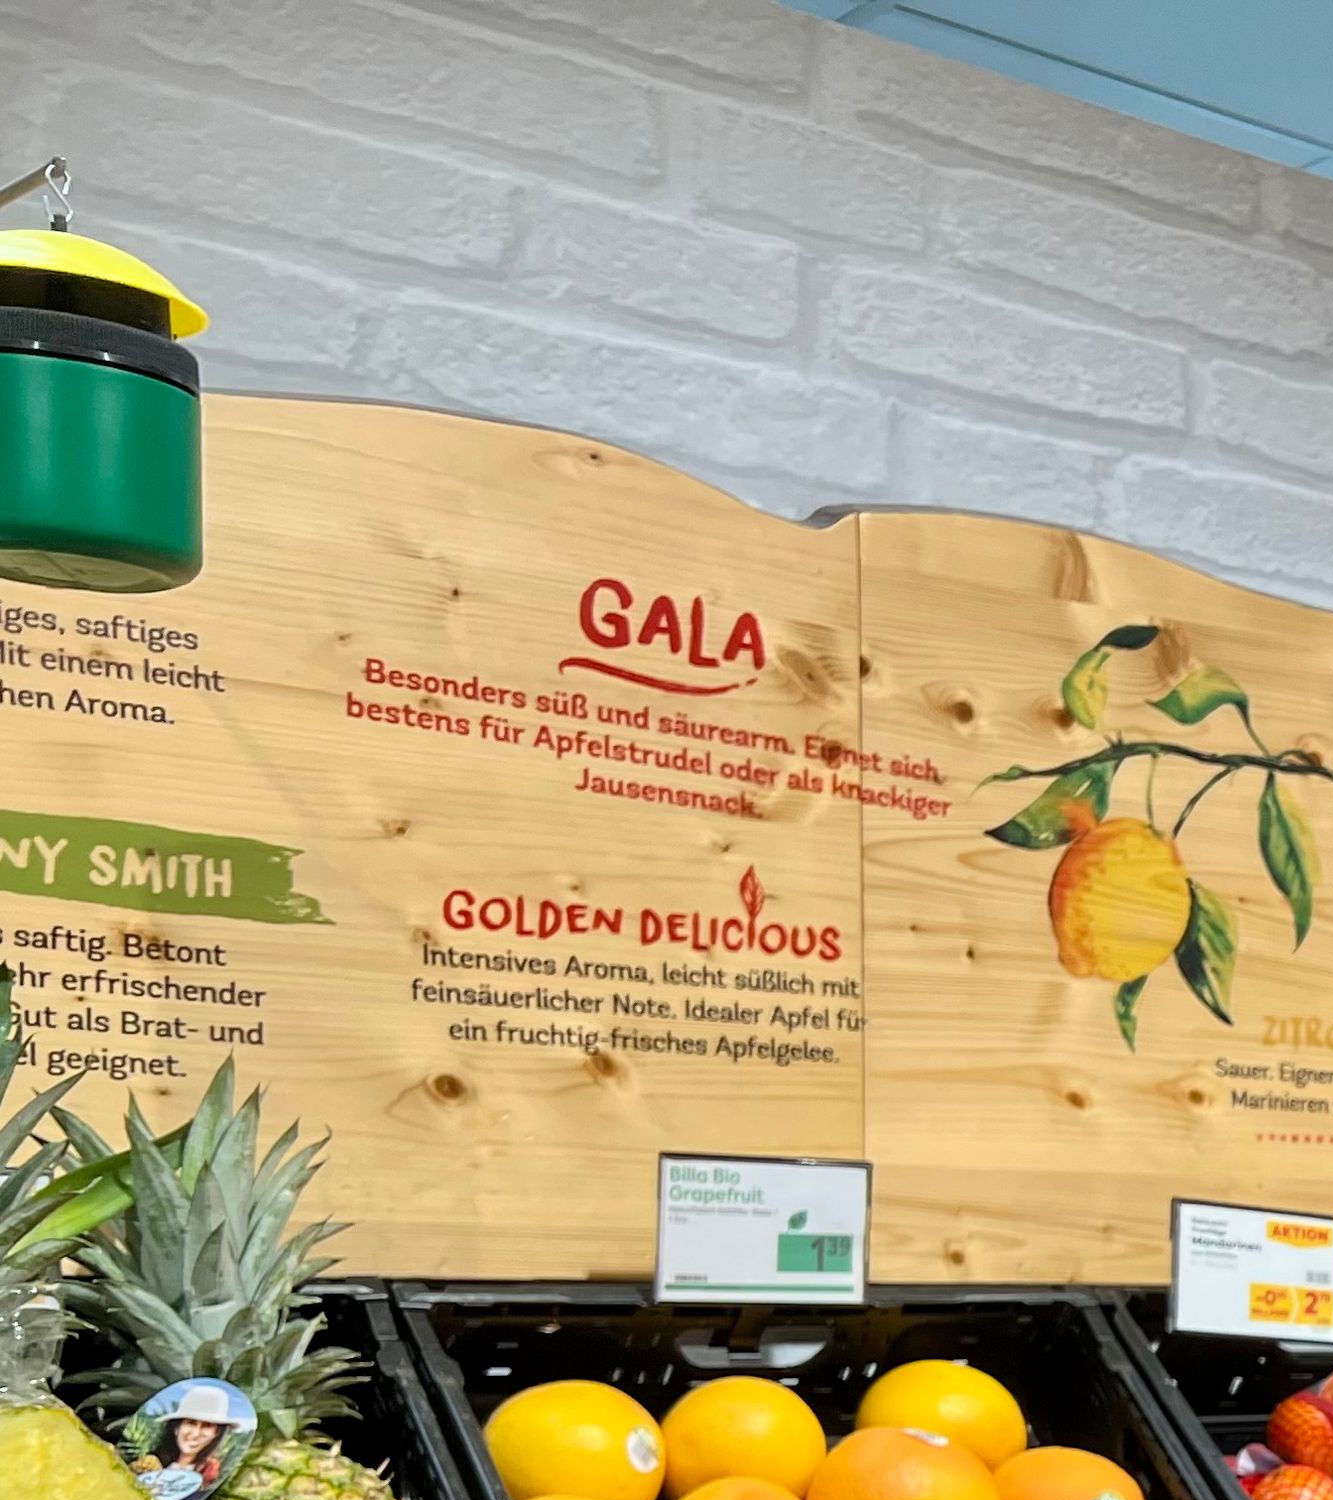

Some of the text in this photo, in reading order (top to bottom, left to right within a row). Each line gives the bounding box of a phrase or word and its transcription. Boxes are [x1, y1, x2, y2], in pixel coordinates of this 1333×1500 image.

[75, 615, 200, 653] saftiges
[579, 578, 766, 671] GALA
[41, 648, 225, 692] einem leicht
[64, 689, 175, 725] Aroma.
[364, 657, 528, 709] Besonders
[536, 691, 588, 720] süß
[597, 705, 650, 730] und
[658, 711, 795, 755] säurearm.
[346, 691, 953, 820] bestens für Apfelstrudel oder als knackiger
[574, 768, 764, 820] Jausensnack.
[88, 845, 233, 898] SMITH
[13, 926, 227, 966] saftig. Betont
[443, 889, 842, 962] GOLDEN DELICIOUS
[61, 970, 267, 1008] erfrischender
[423, 943, 863, 999] Intensives Aroma, leicht süßlich mit
[411, 977, 604, 1014] feinsäuerlicher
[612, 993, 677, 1020] Note.
[685, 997, 764, 1025] Idealer
[769, 1004, 830, 1034] Apfel
[67, 1008, 110, 1033] als
[120, 1010, 199, 1039] Brat-
[209, 1022, 265, 1046] und
[449, 1018, 840, 1067] ein fruchtig-frisches Apfelgelee.
[47, 1047, 187, 1080] geeignet.
[1231, 1089, 1330, 1115] Marinieren
[668, 1184, 766, 1205] Grapefruit
[669, 1165, 709, 1184] Billa
[1272, 1224, 1329, 1242] AKTION
